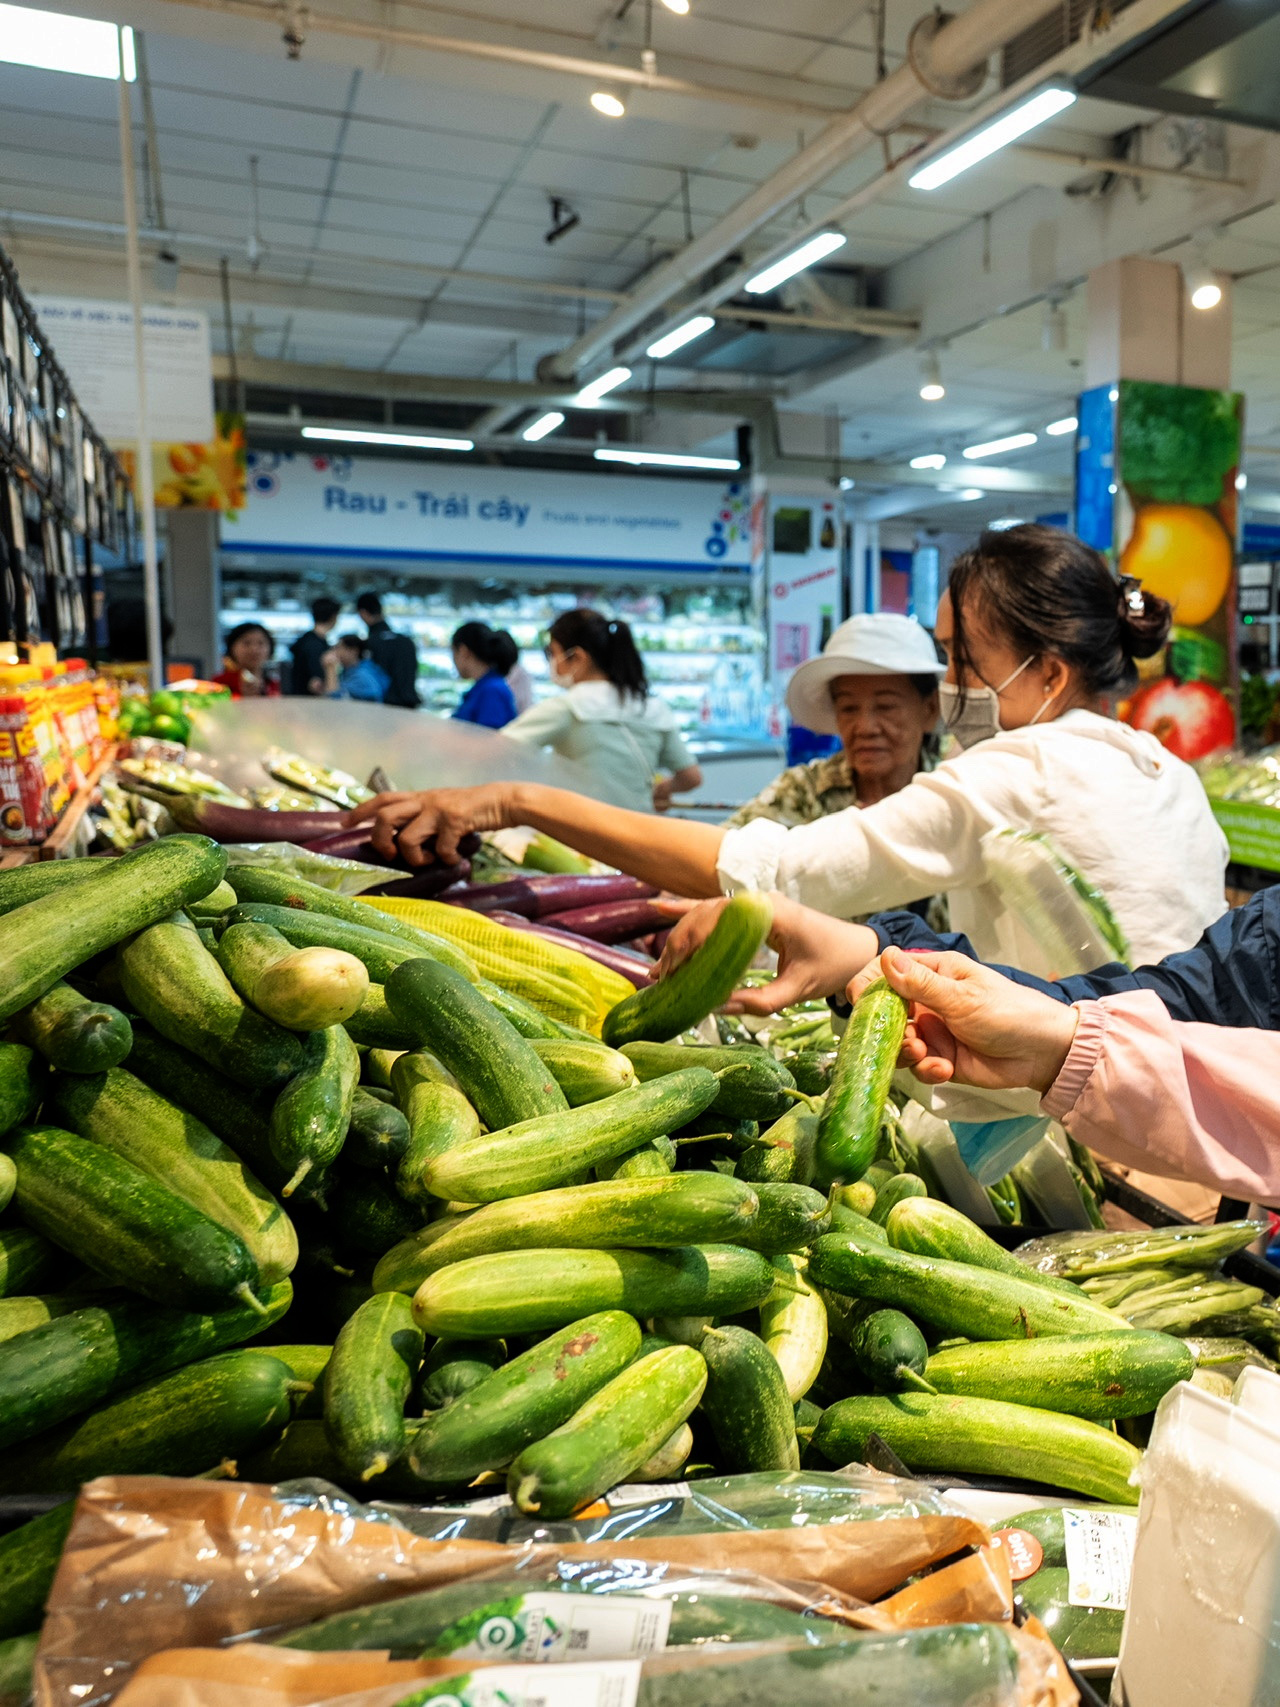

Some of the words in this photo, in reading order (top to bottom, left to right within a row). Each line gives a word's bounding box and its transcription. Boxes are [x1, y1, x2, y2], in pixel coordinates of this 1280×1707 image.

[324, 485, 387, 515] Rau
[414, 490, 470, 518] Trái
[477, 496, 531, 527] cây
